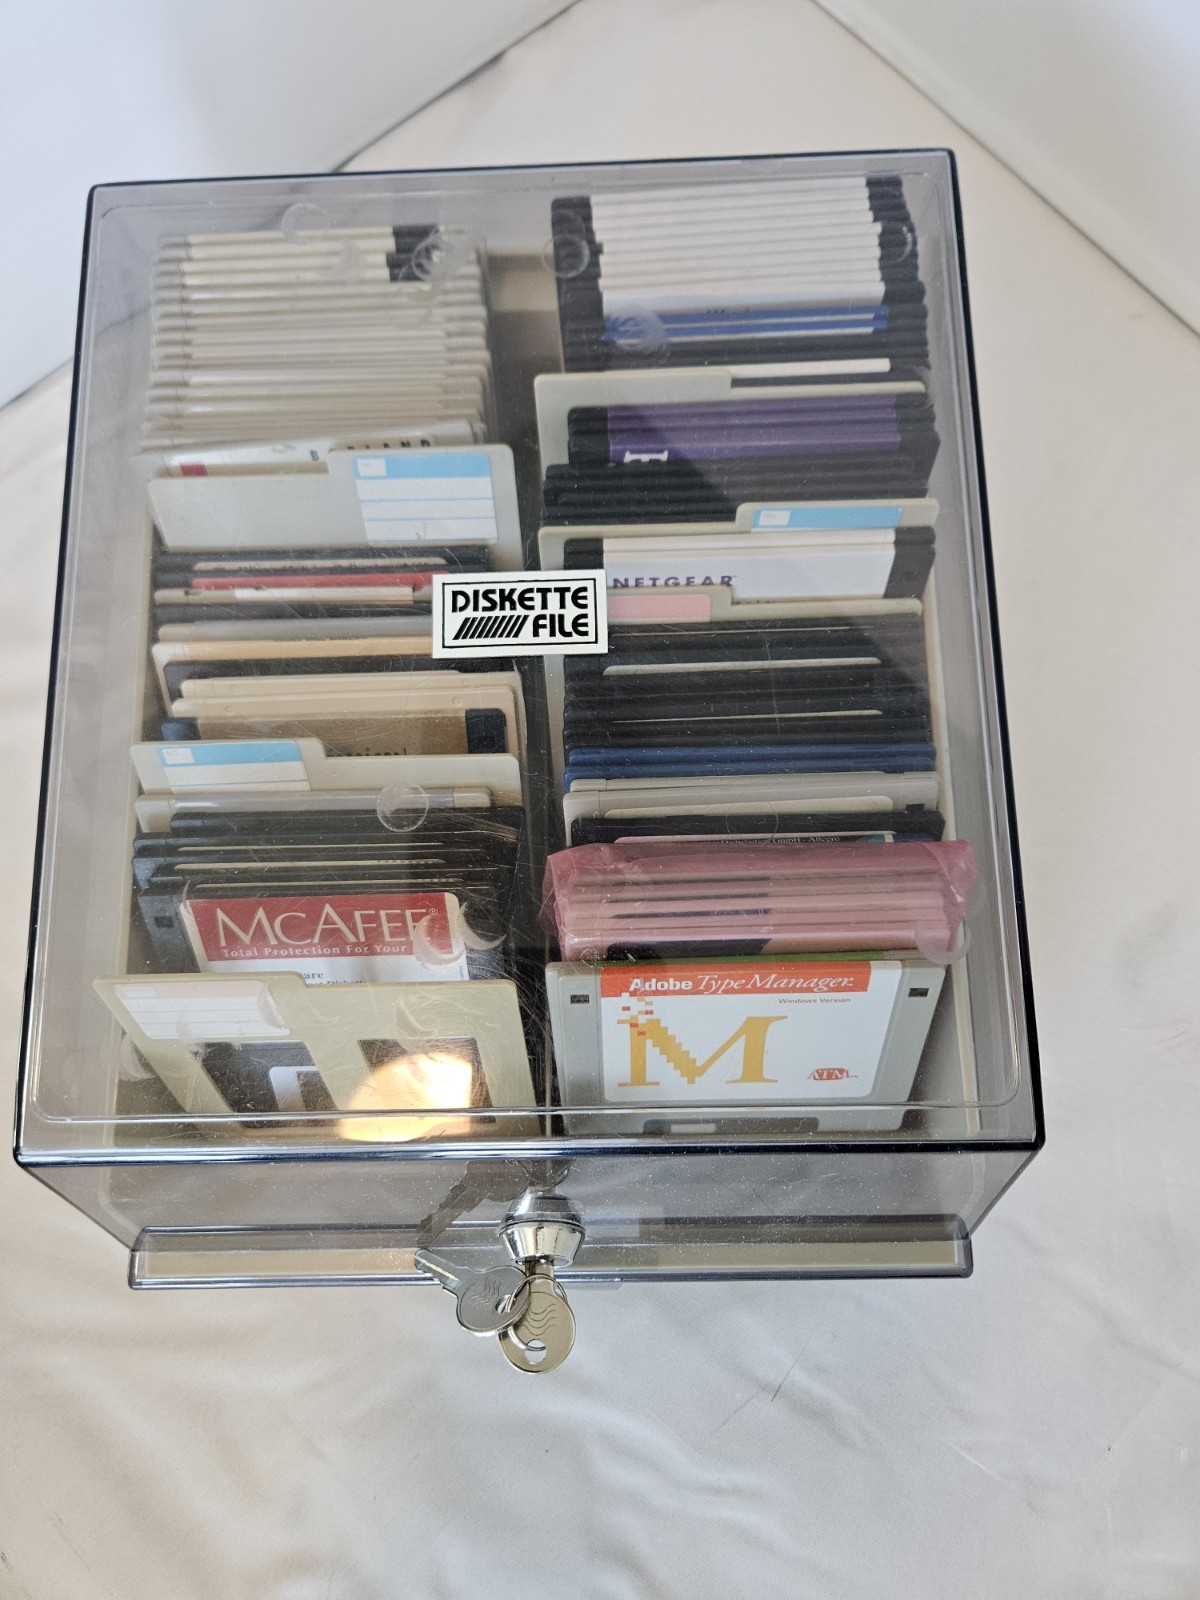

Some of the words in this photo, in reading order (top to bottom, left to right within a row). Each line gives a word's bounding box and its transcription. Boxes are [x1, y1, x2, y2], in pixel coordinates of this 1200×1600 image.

[613, 575, 734, 589] NETGEAR
[452, 586, 588, 613] DISKETTE
[532, 613, 589, 638] FILE
[222, 947, 259, 958] Total
[264, 945, 340, 957] Protection
[347, 944, 370, 954] For
[374, 943, 407, 954] Your
[629, 977, 693, 992] Adobe
[696, 974, 746, 995] Type
[818, 996, 852, 1004] Version
